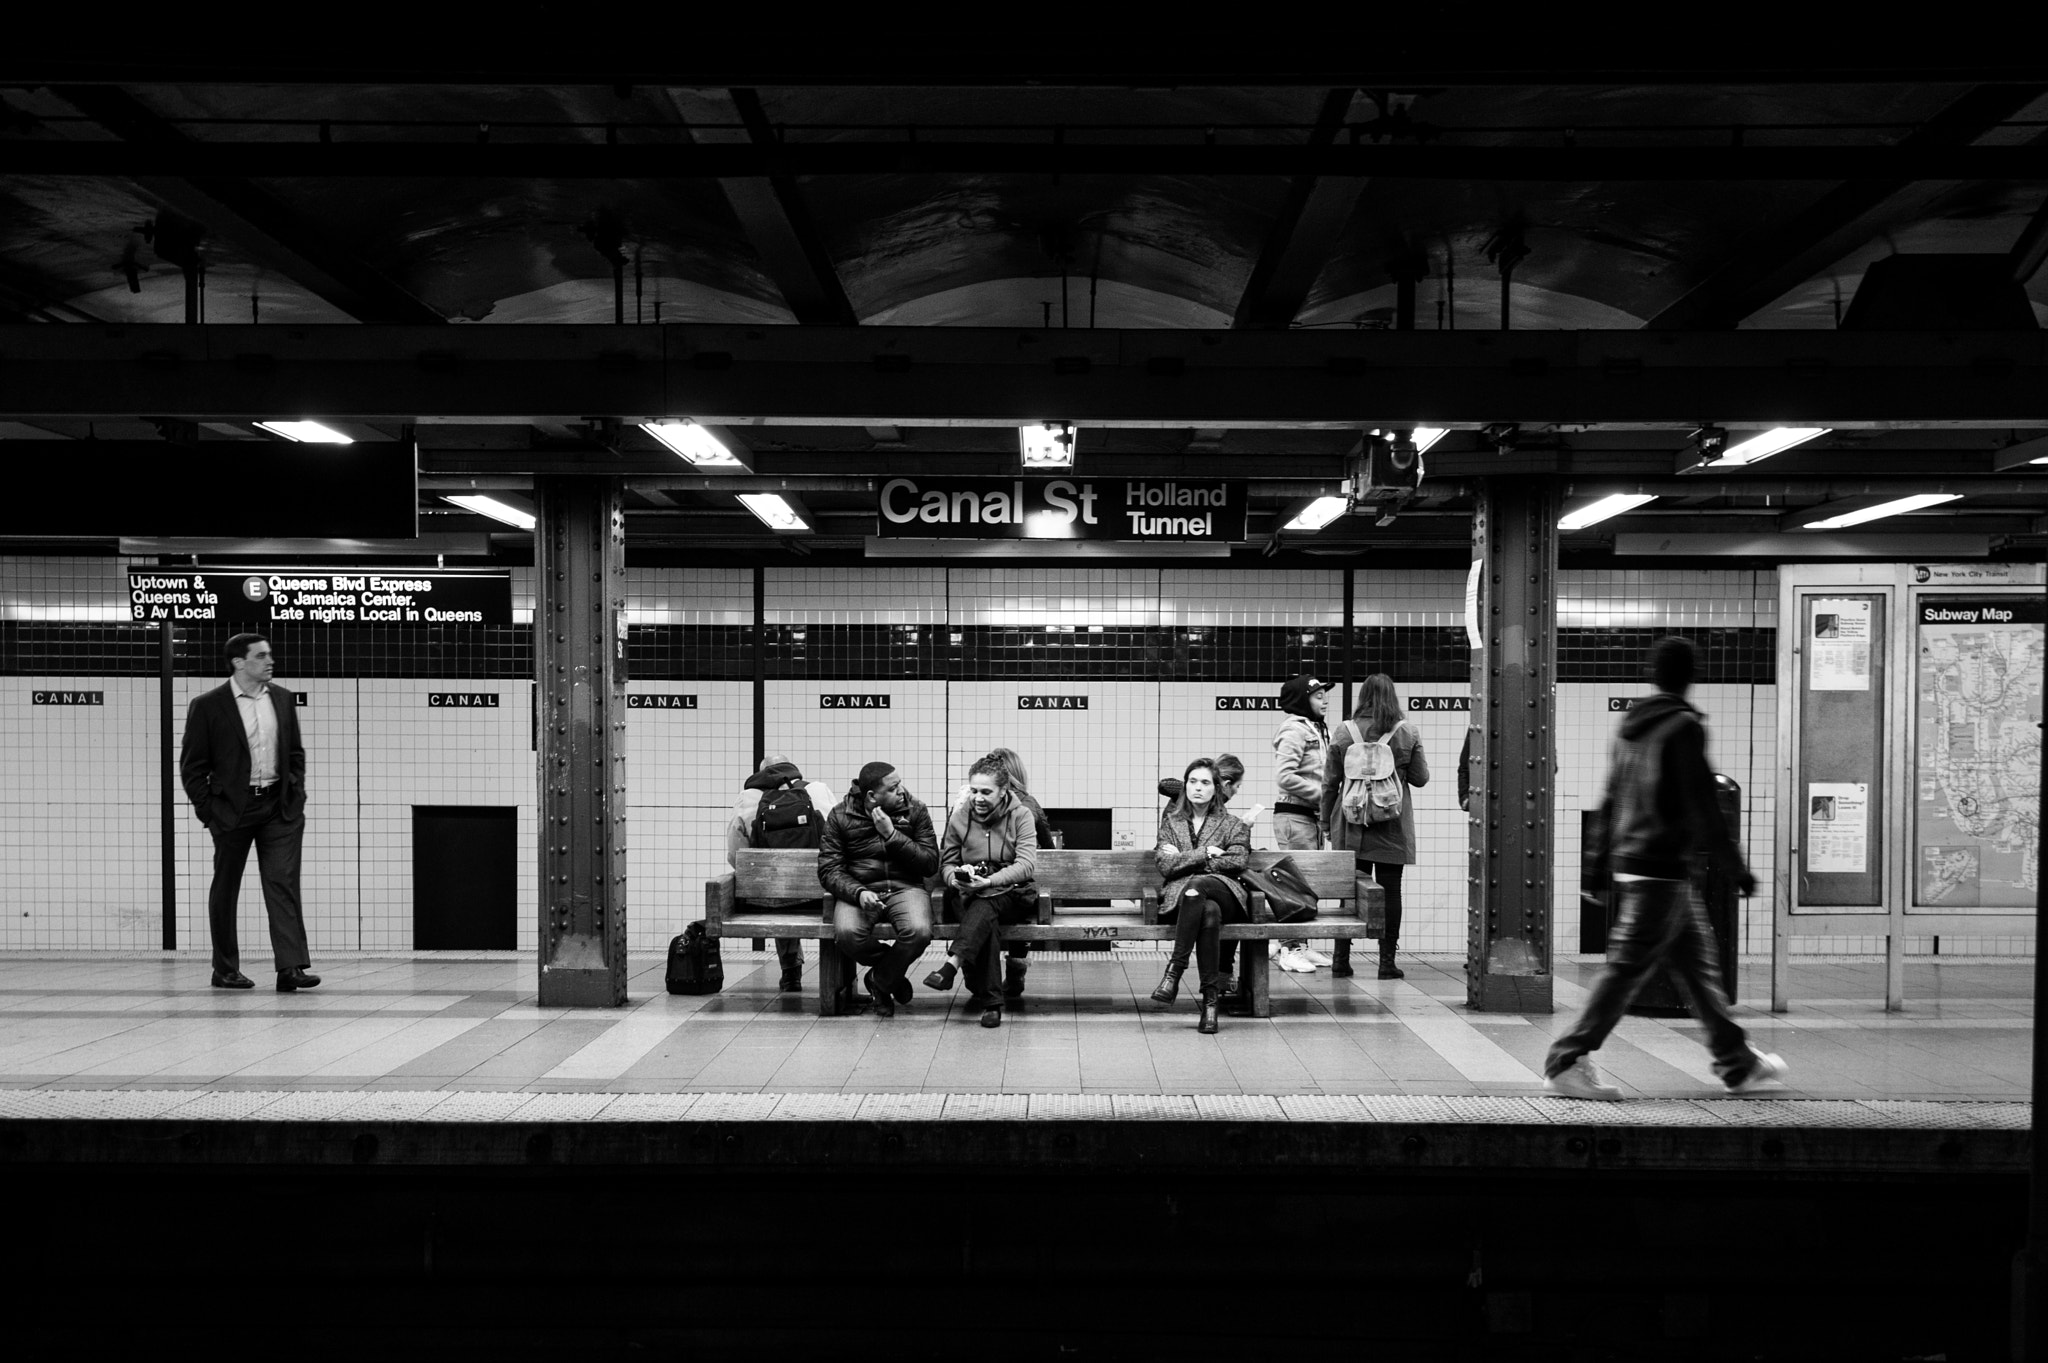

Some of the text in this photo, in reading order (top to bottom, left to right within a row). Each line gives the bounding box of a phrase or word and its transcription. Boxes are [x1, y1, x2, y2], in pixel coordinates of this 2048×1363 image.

[880, 478, 1099, 525] Canal St
[1126, 482, 1227, 507] Holland
[1126, 511, 1213, 536] Tunnel
[1969, 571, 1982, 579] City
[130, 575, 206, 591] Uptown &
[249, 581, 262, 597] E
[268, 575, 432, 593] Queens Blvd Express
[132, 590, 219, 605] Queens via
[269, 591, 417, 607] To Jamaica Center.
[133, 605, 216, 619] 8 Av Local
[270, 606, 483, 623] Late nights Local in Queens
[1924, 608, 2013, 622] Subway Map
[34, 693, 101, 704] CANAL
[430, 695, 497, 706] CANAL
[629, 696, 695, 707] CANAL
[822, 696, 888, 707] CANAL
[1020, 698, 1086, 708] CANAL
[1217, 698, 1283, 709] CANAL
